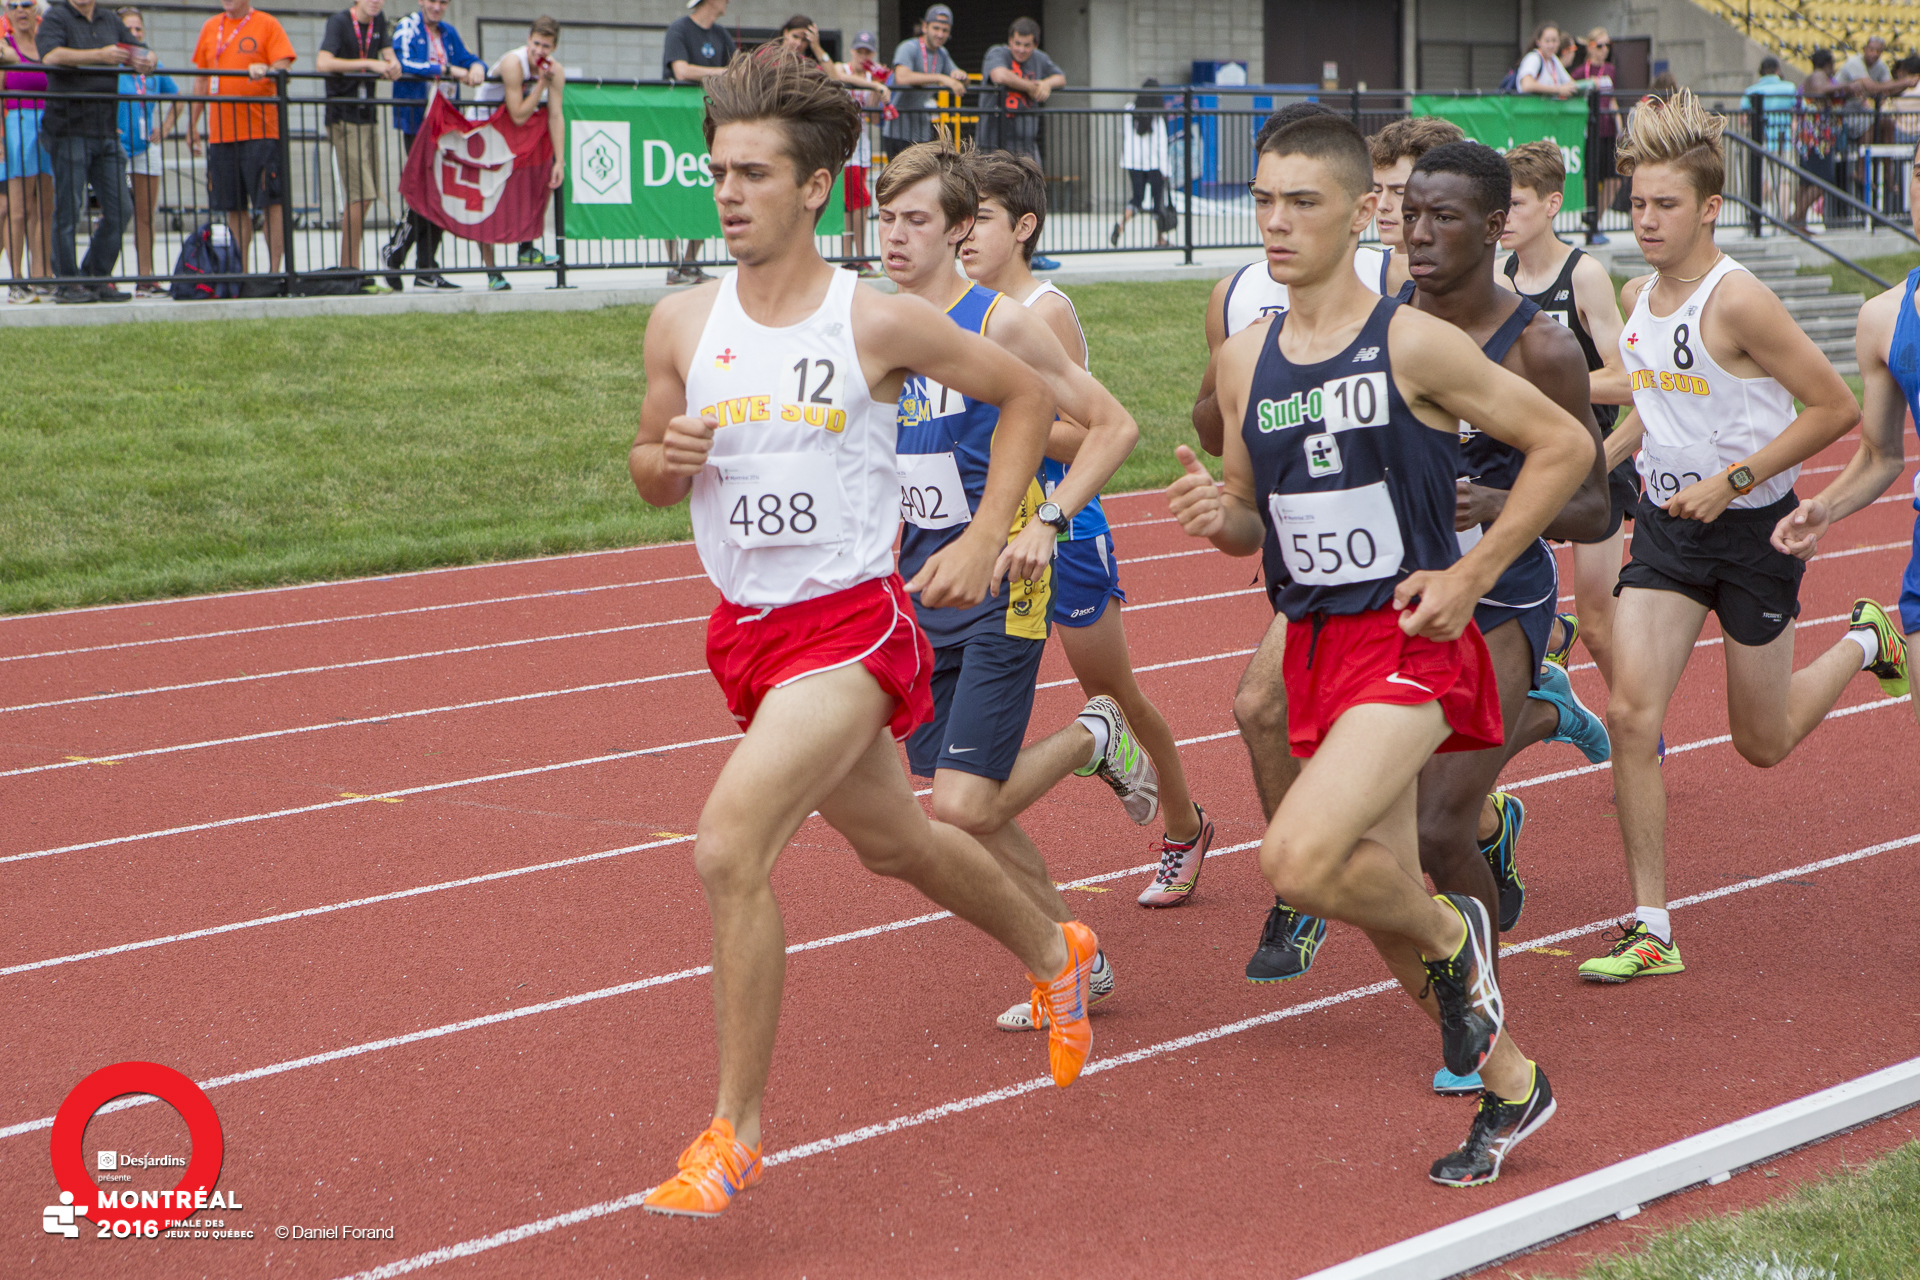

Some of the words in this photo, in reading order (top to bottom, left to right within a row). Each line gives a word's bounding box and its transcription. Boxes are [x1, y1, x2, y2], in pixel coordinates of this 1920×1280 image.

[1673, 323, 1694, 370] 8
[794, 358, 835, 405] 12
[1334, 377, 1376, 425] 10
[1627, 368, 1658, 391] IVE
[1659, 370, 1710, 396] SUD
[781, 404, 846, 433] SUD
[729, 492, 817, 536] 488
[901, 485, 949, 519] 402
[1292, 528, 1376, 574] 550
